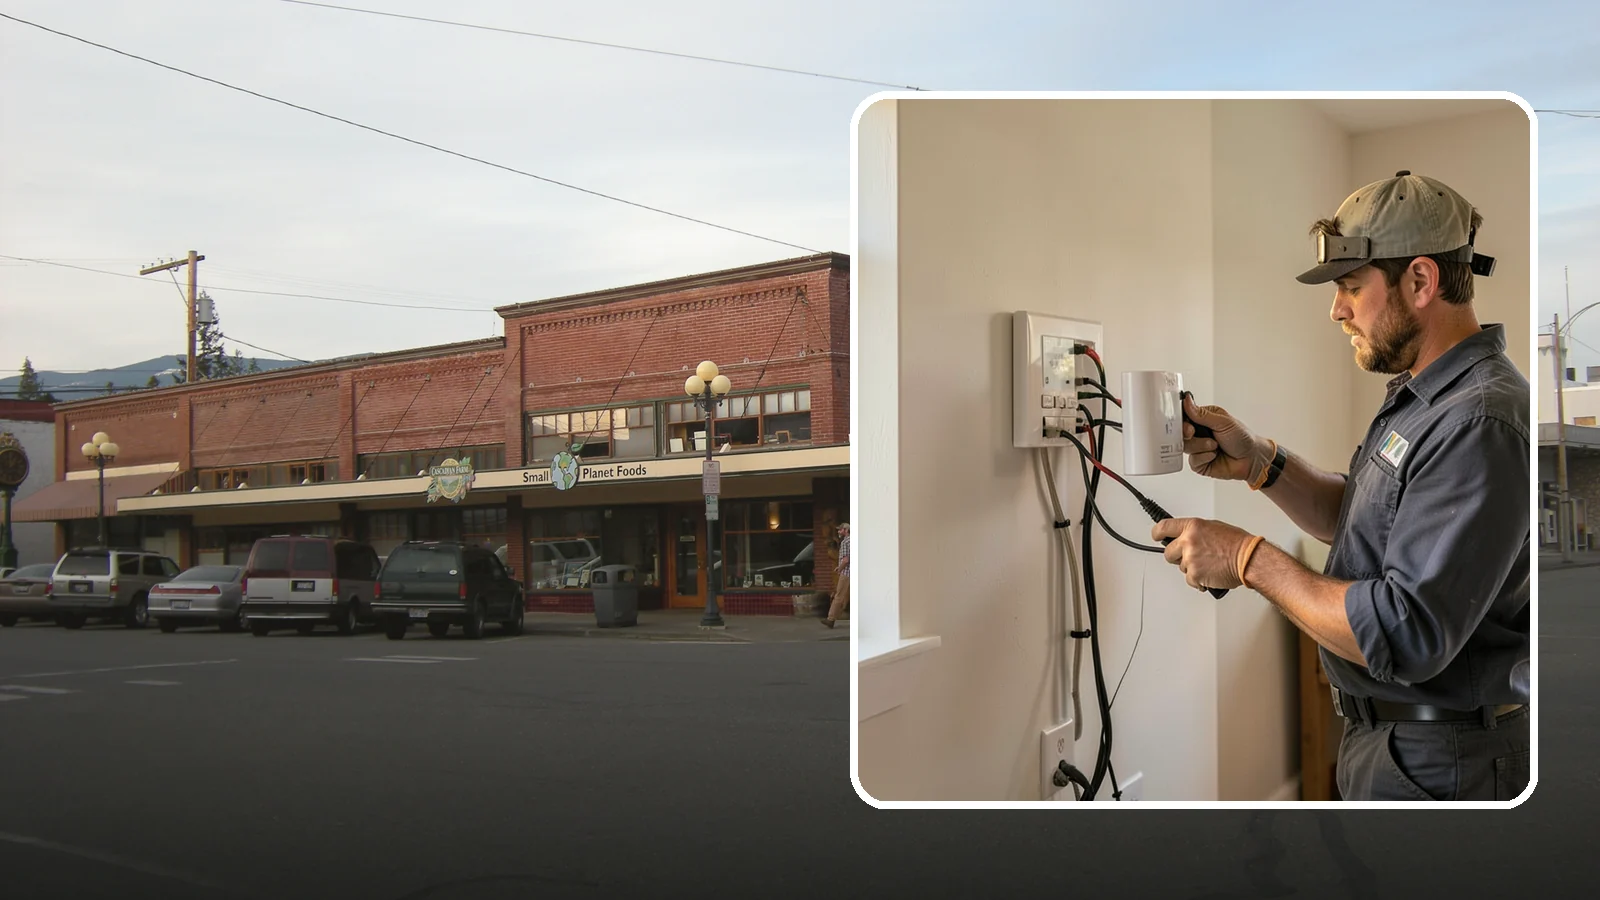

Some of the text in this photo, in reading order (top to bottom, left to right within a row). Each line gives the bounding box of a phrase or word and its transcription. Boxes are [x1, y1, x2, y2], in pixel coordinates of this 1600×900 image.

[523, 464, 647, 483] Small Planet Foods
